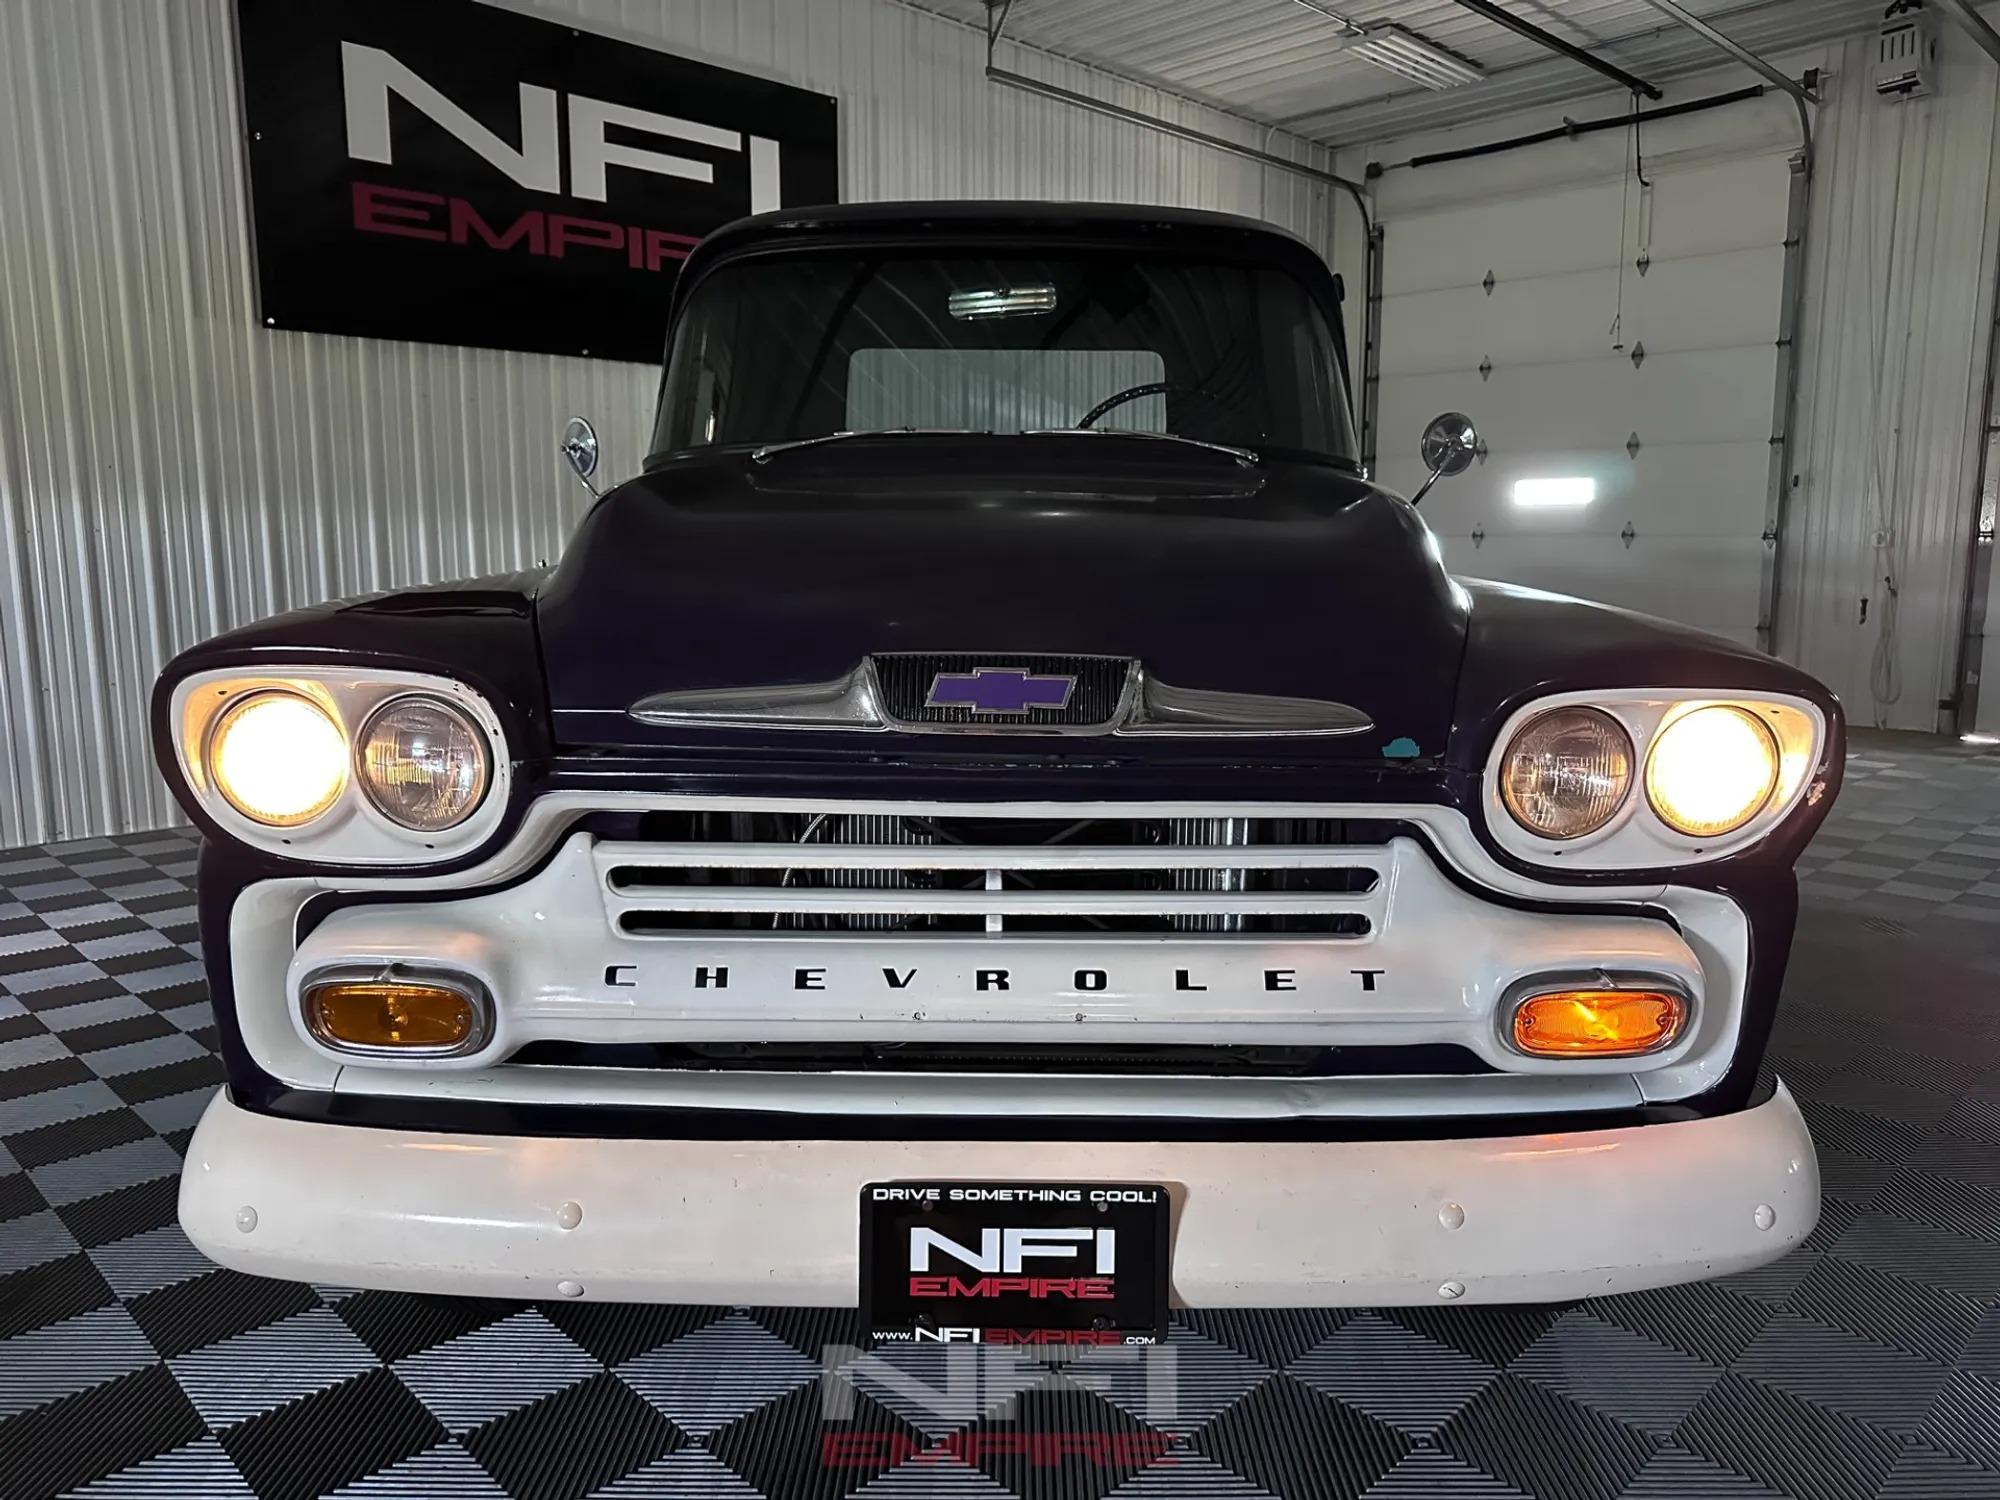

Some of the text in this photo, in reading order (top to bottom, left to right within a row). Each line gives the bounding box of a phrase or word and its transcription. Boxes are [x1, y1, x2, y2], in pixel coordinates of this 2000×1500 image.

[341, 41, 781, 216] NFI
[351, 182, 704, 271] EMPIR
[604, 965, 1386, 992] CHEVROLET
[872, 1188, 1158, 1203] DRIVE SOMETHING COOL!
[910, 1227, 1115, 1274] NFI
[909, 1277, 1115, 1299] EMPIRE
